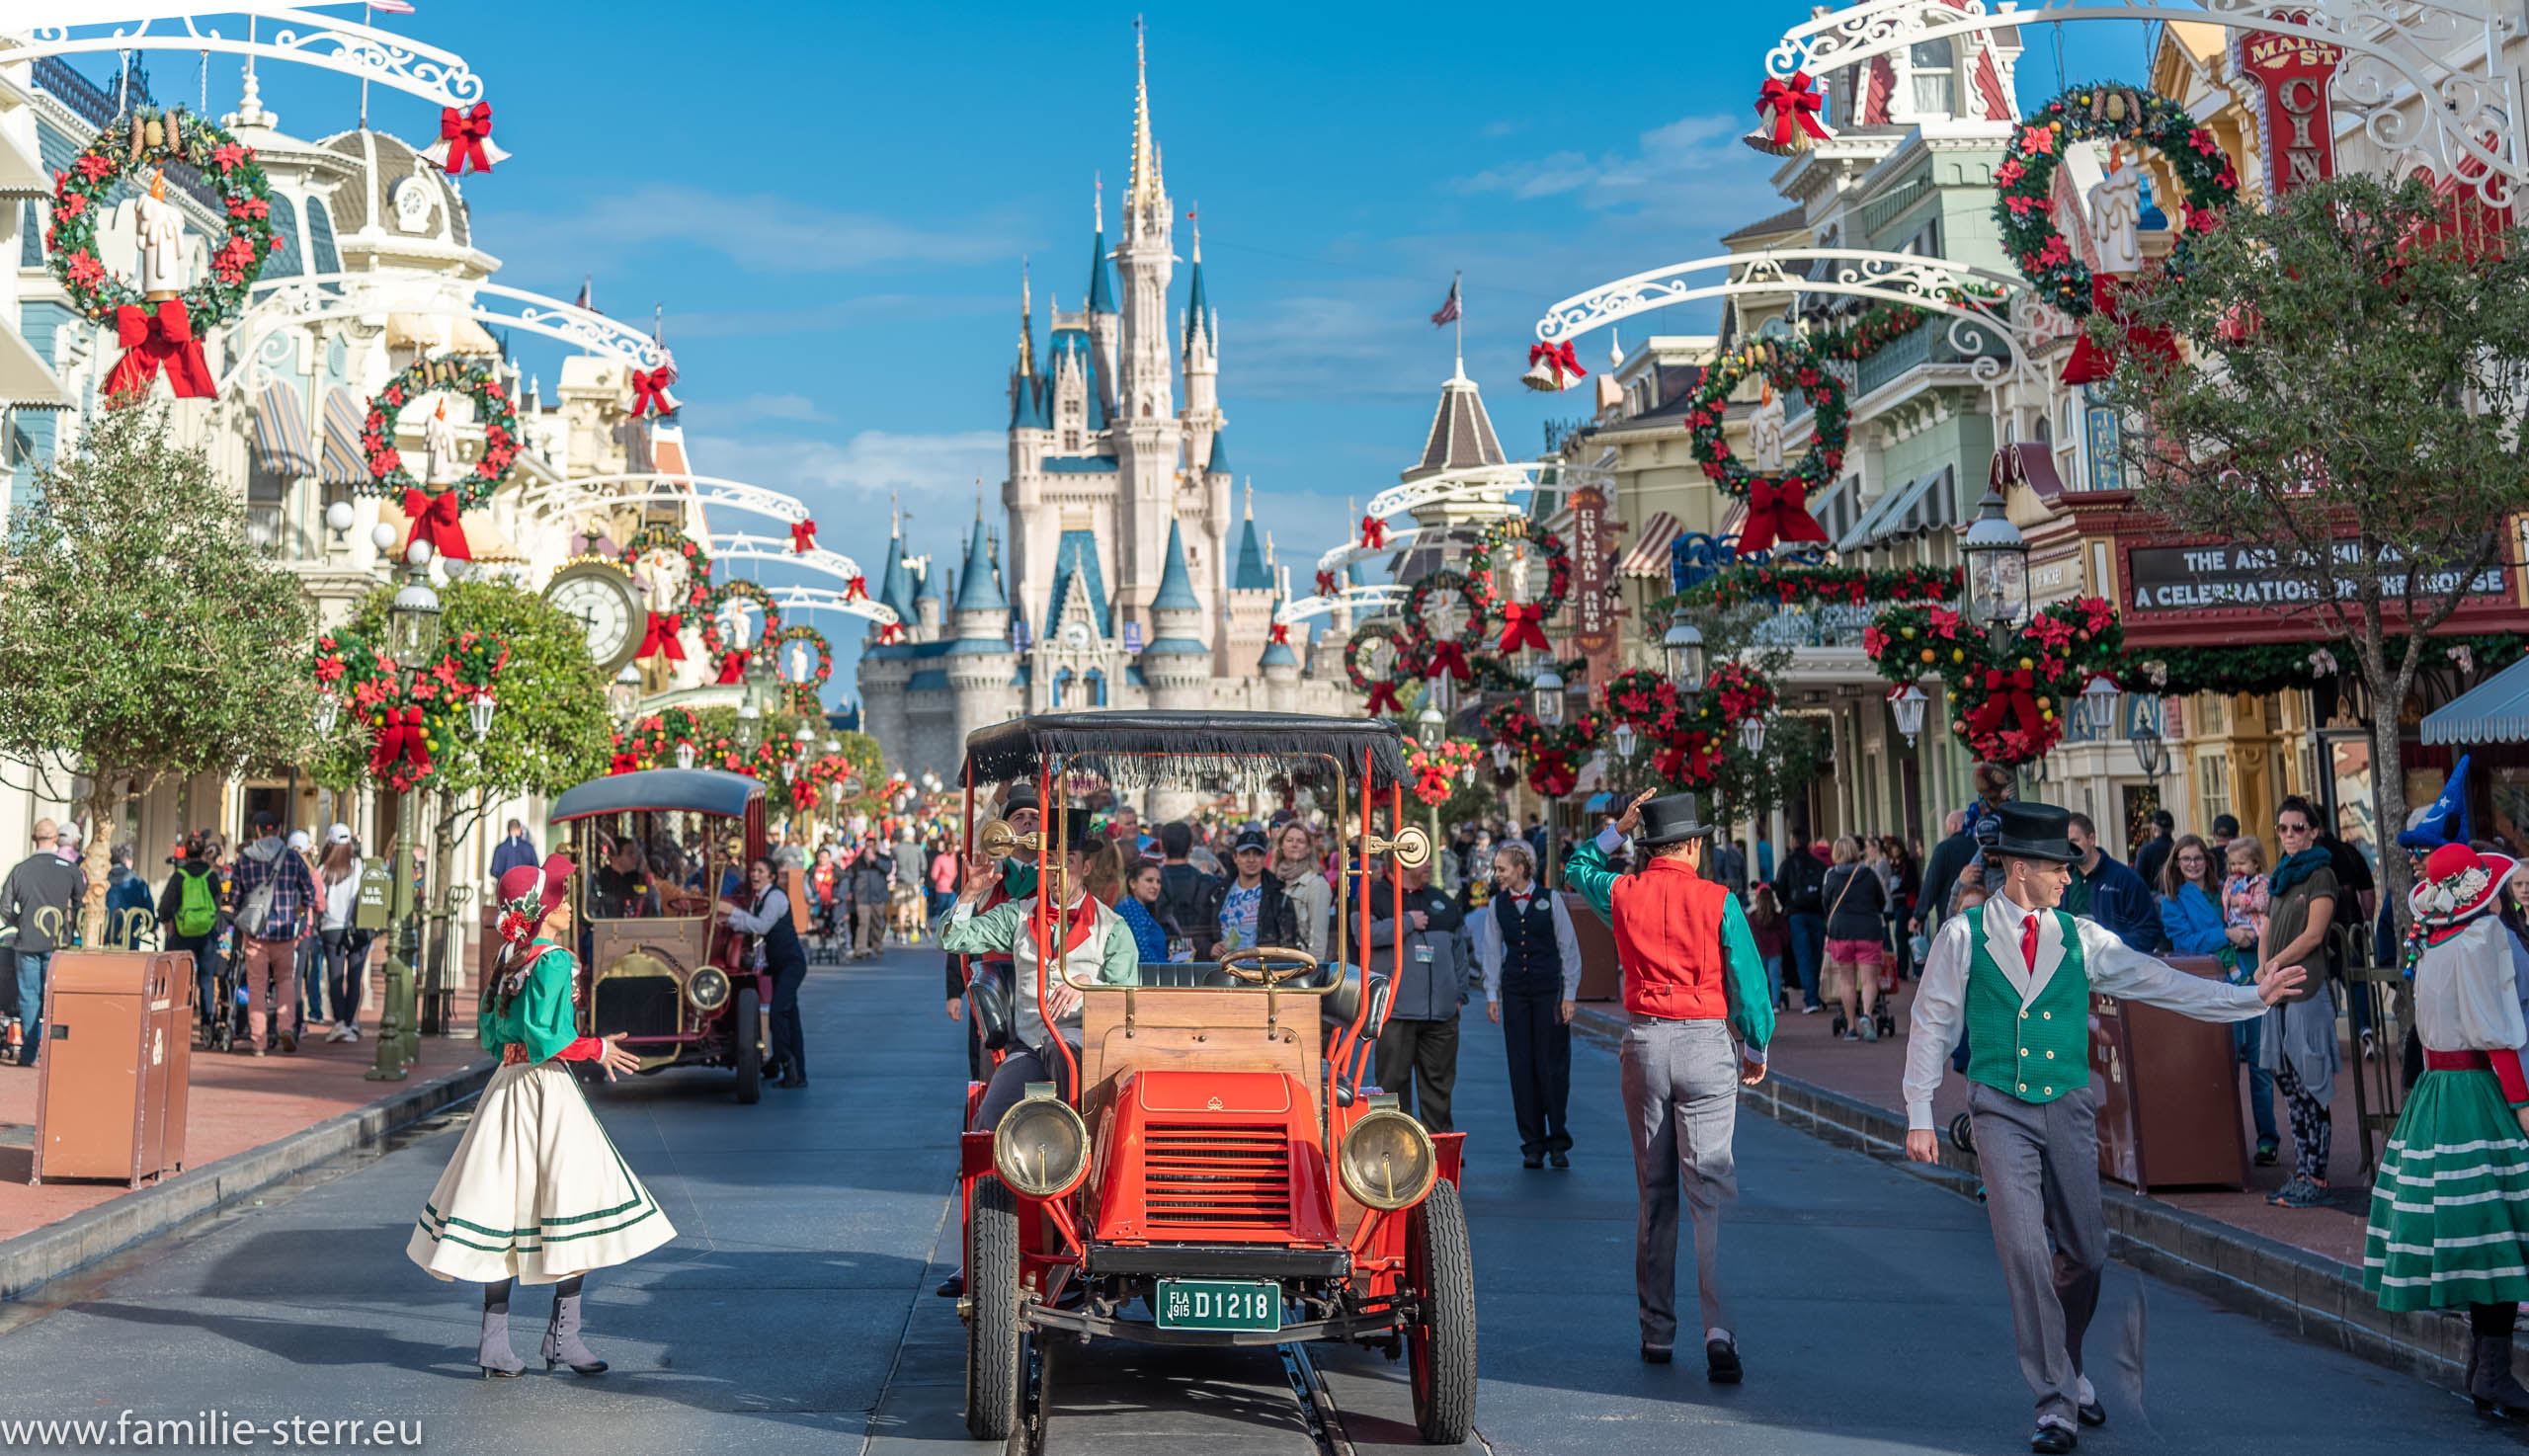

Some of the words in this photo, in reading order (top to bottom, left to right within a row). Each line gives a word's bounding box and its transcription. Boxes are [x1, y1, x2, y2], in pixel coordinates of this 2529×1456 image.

[2250, 37, 2328, 63] MAIN
[1581, 509, 1597, 581] CRYSTAL
[2183, 551, 2227, 572] THE
[2135, 587, 2153, 607] A
[2157, 579, 2320, 607] CELEBRATION
[1584, 590, 1599, 632] ARTS
[1170, 1291, 1189, 1304] FLA
[1194, 1291, 1267, 1320] D1218
[1167, 1304, 1190, 1321] 1915
